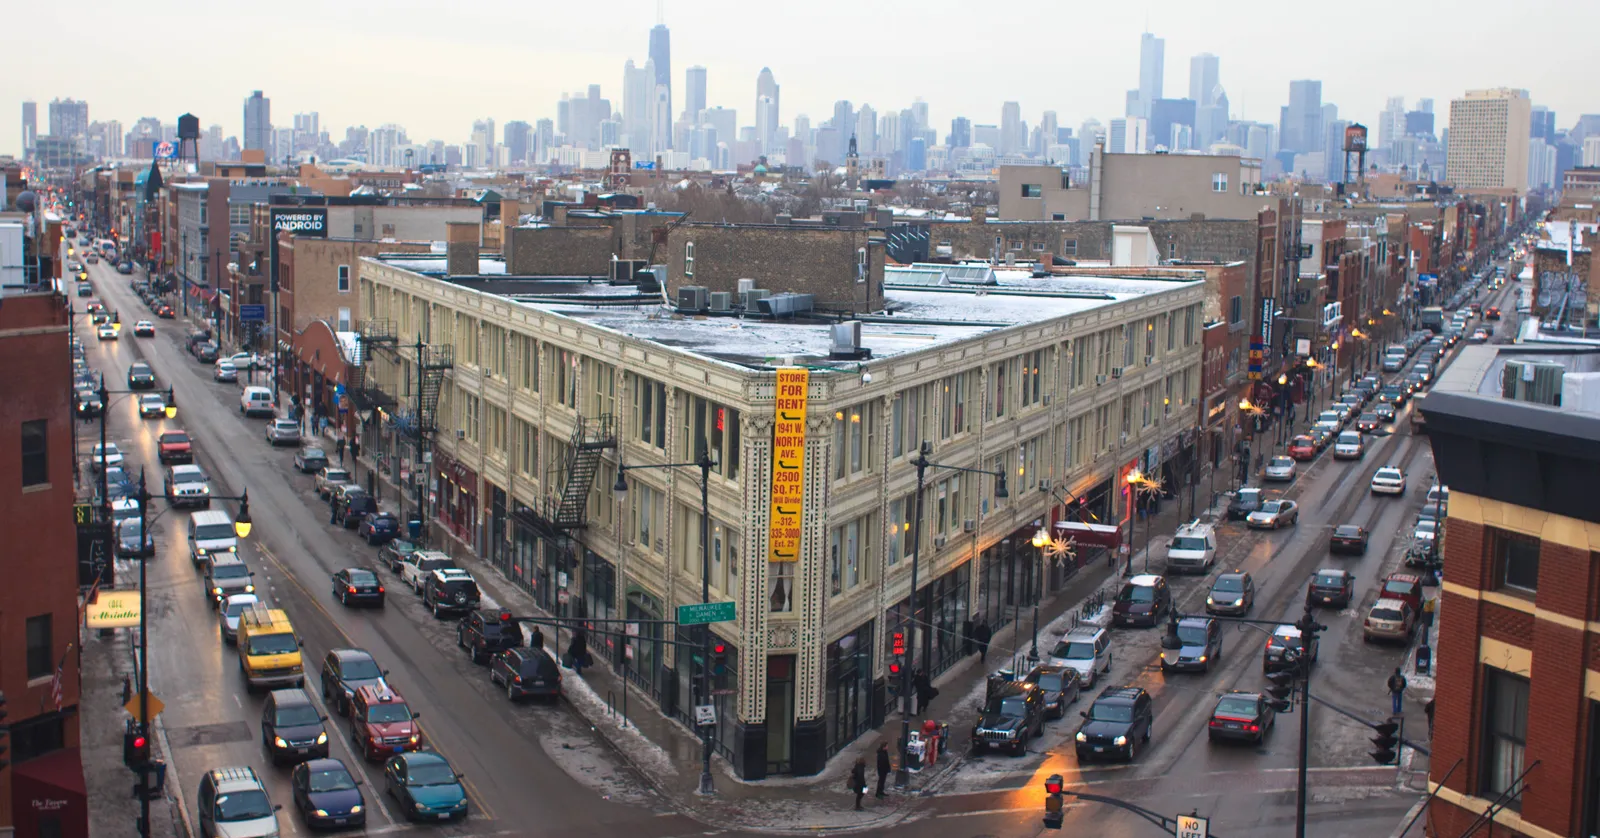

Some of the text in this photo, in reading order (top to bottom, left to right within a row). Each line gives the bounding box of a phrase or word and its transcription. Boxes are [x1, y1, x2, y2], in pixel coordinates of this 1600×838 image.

[275, 221, 322, 231] ANDROID
[779, 373, 806, 383] STORE
[781, 385, 803, 396] FOR
[777, 398, 805, 410] RENT
[777, 422, 803, 433] 1941 W.
[775, 436, 804, 447] NORTH
[780, 449, 797, 459] AVE.
[776, 471, 800, 482] 2500
[773, 485, 801, 495] SQ. FT.
[773, 496, 801, 504] Will Divide
[770, 528, 800, 539] 335-3000
[774, 540, 795, 549] Ext. 25
[690, 604, 722, 612] MILWAUKEE
[695, 610, 718, 618] DAMEN
[1184, 821, 1199, 830] NO
